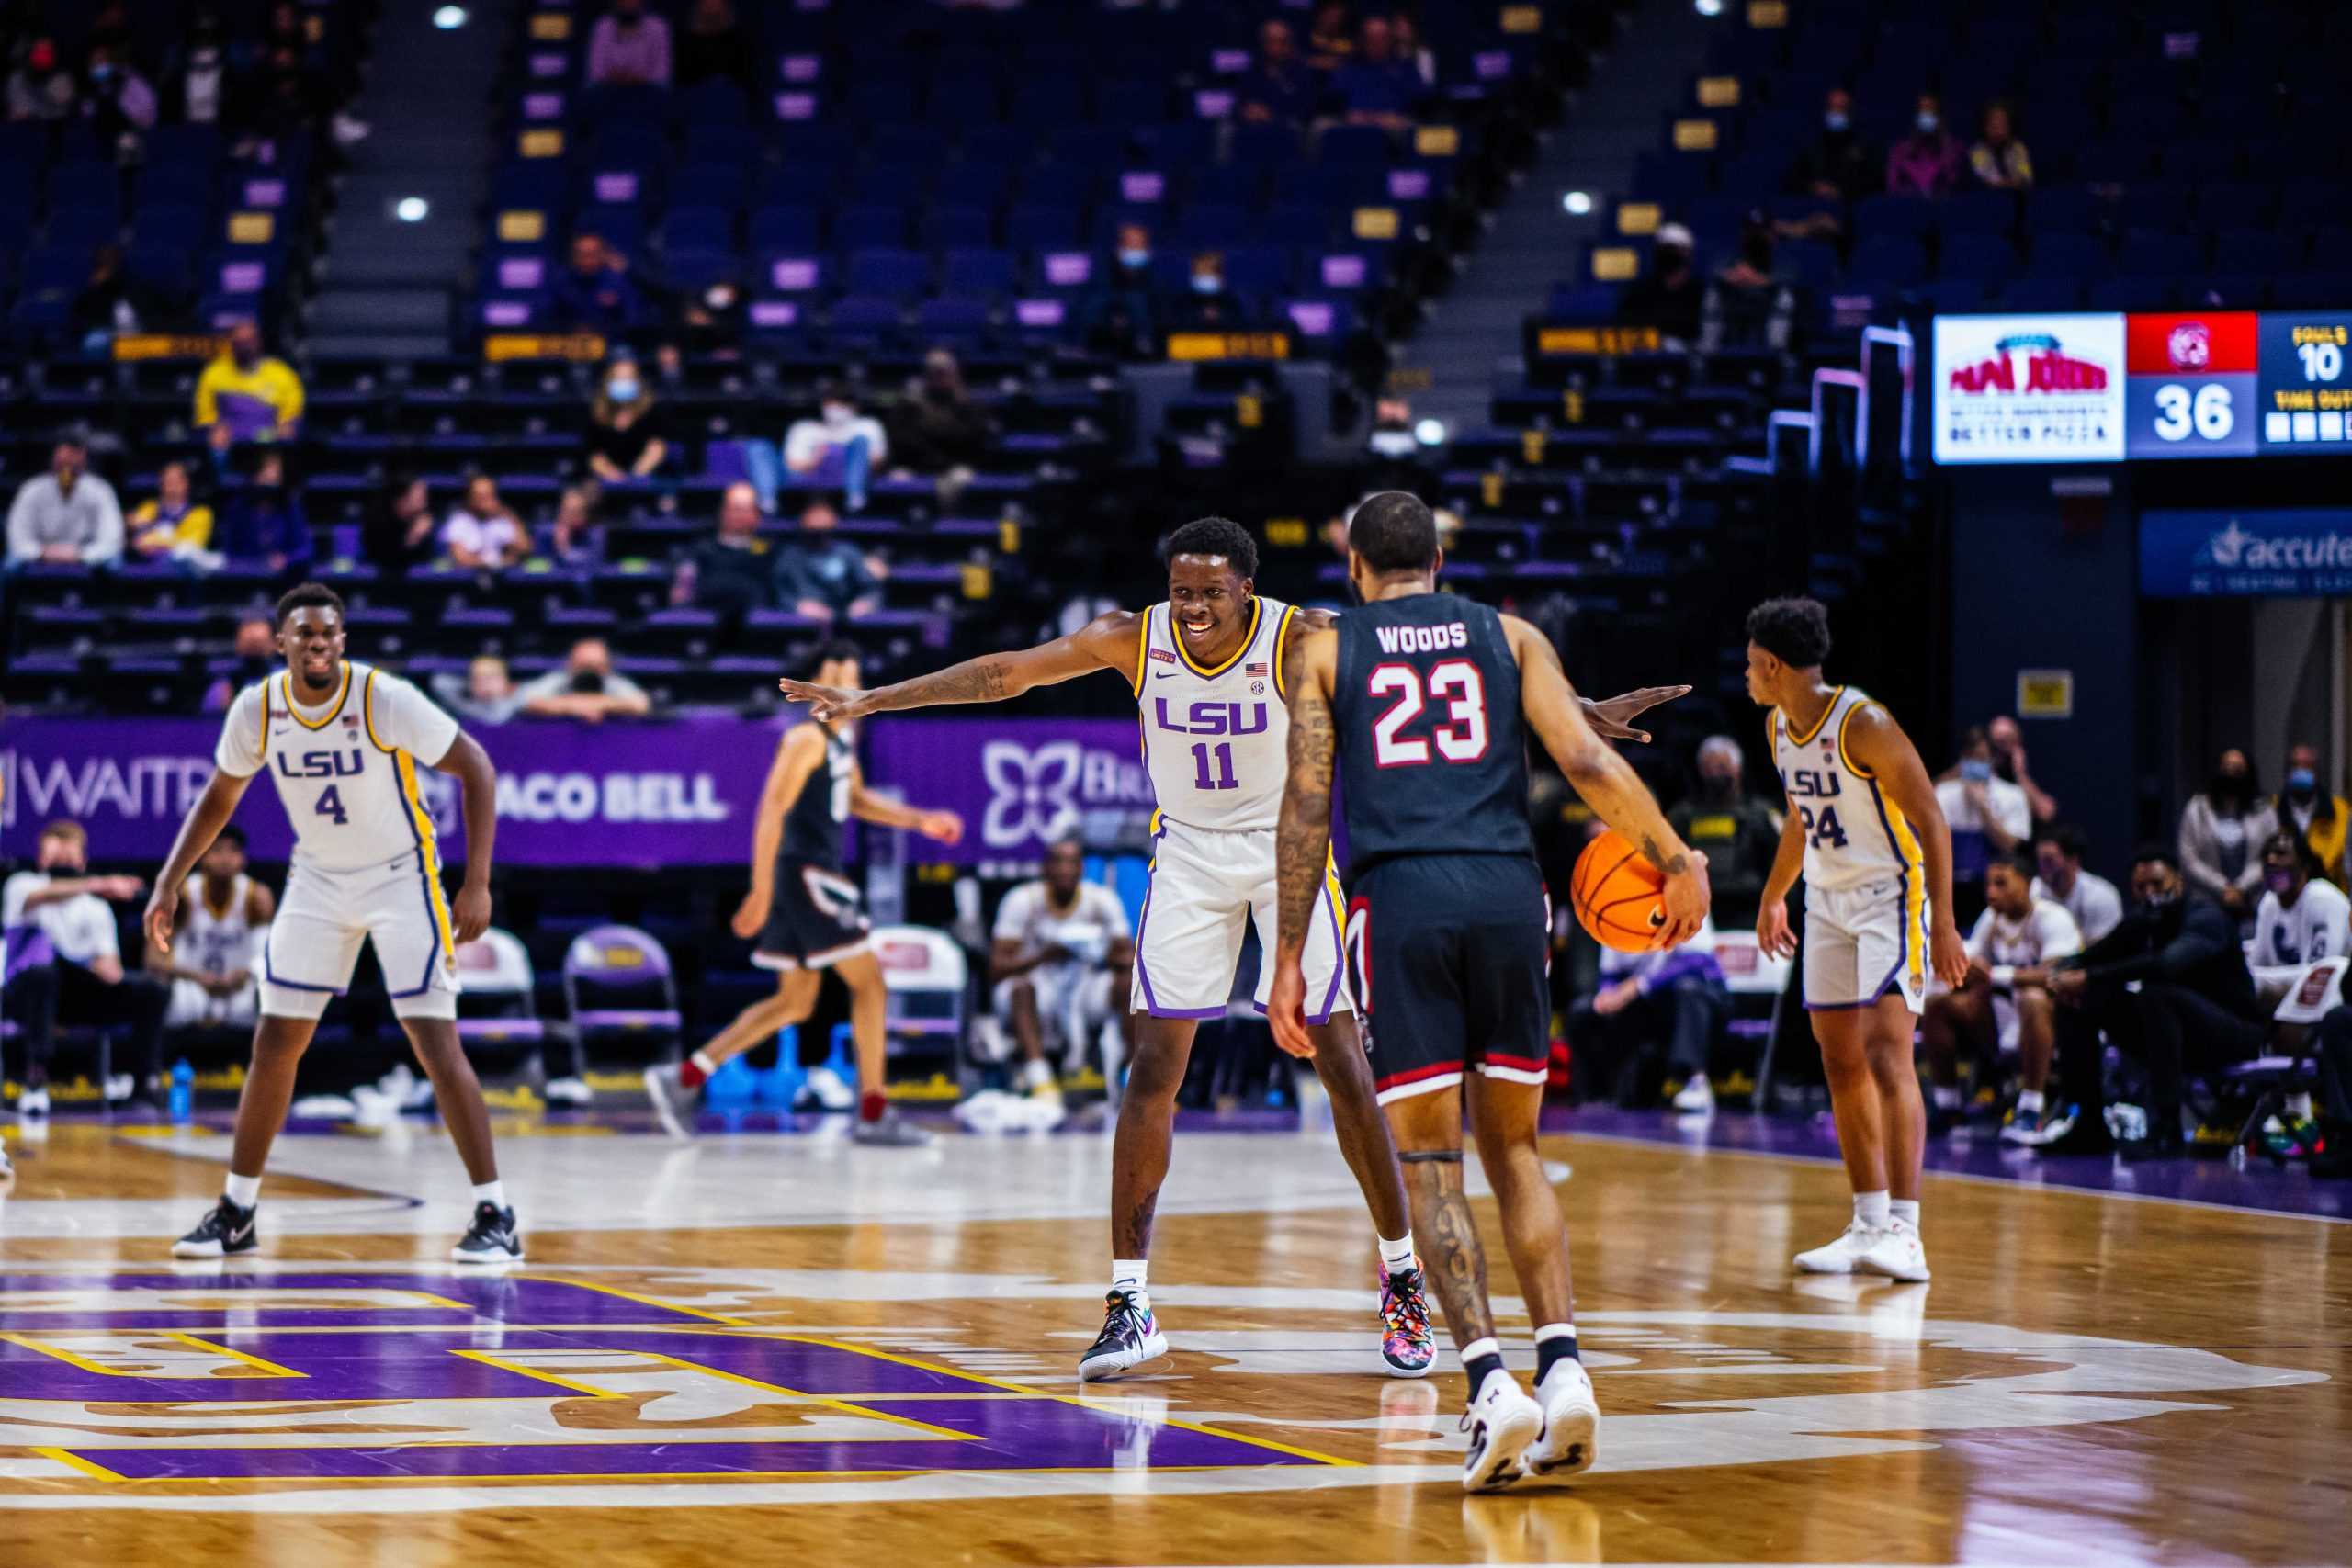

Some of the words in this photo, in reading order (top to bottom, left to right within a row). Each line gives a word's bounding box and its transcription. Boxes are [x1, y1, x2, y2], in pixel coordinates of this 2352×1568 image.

[2298, 343, 2343, 381] 10
[2154, 383, 2233, 441] 36
[1375, 622, 1468, 654] WOODS
[1155, 697, 1268, 736] LSU
[1367, 658, 1488, 770] 23
[277, 748, 364, 778] LSU
[1191, 742, 1238, 790] 11
[496, 773, 597, 821] ACO
[603, 773, 728, 820] BELL
[1781, 770, 1841, 797] LSU
[314, 784, 348, 825] 4
